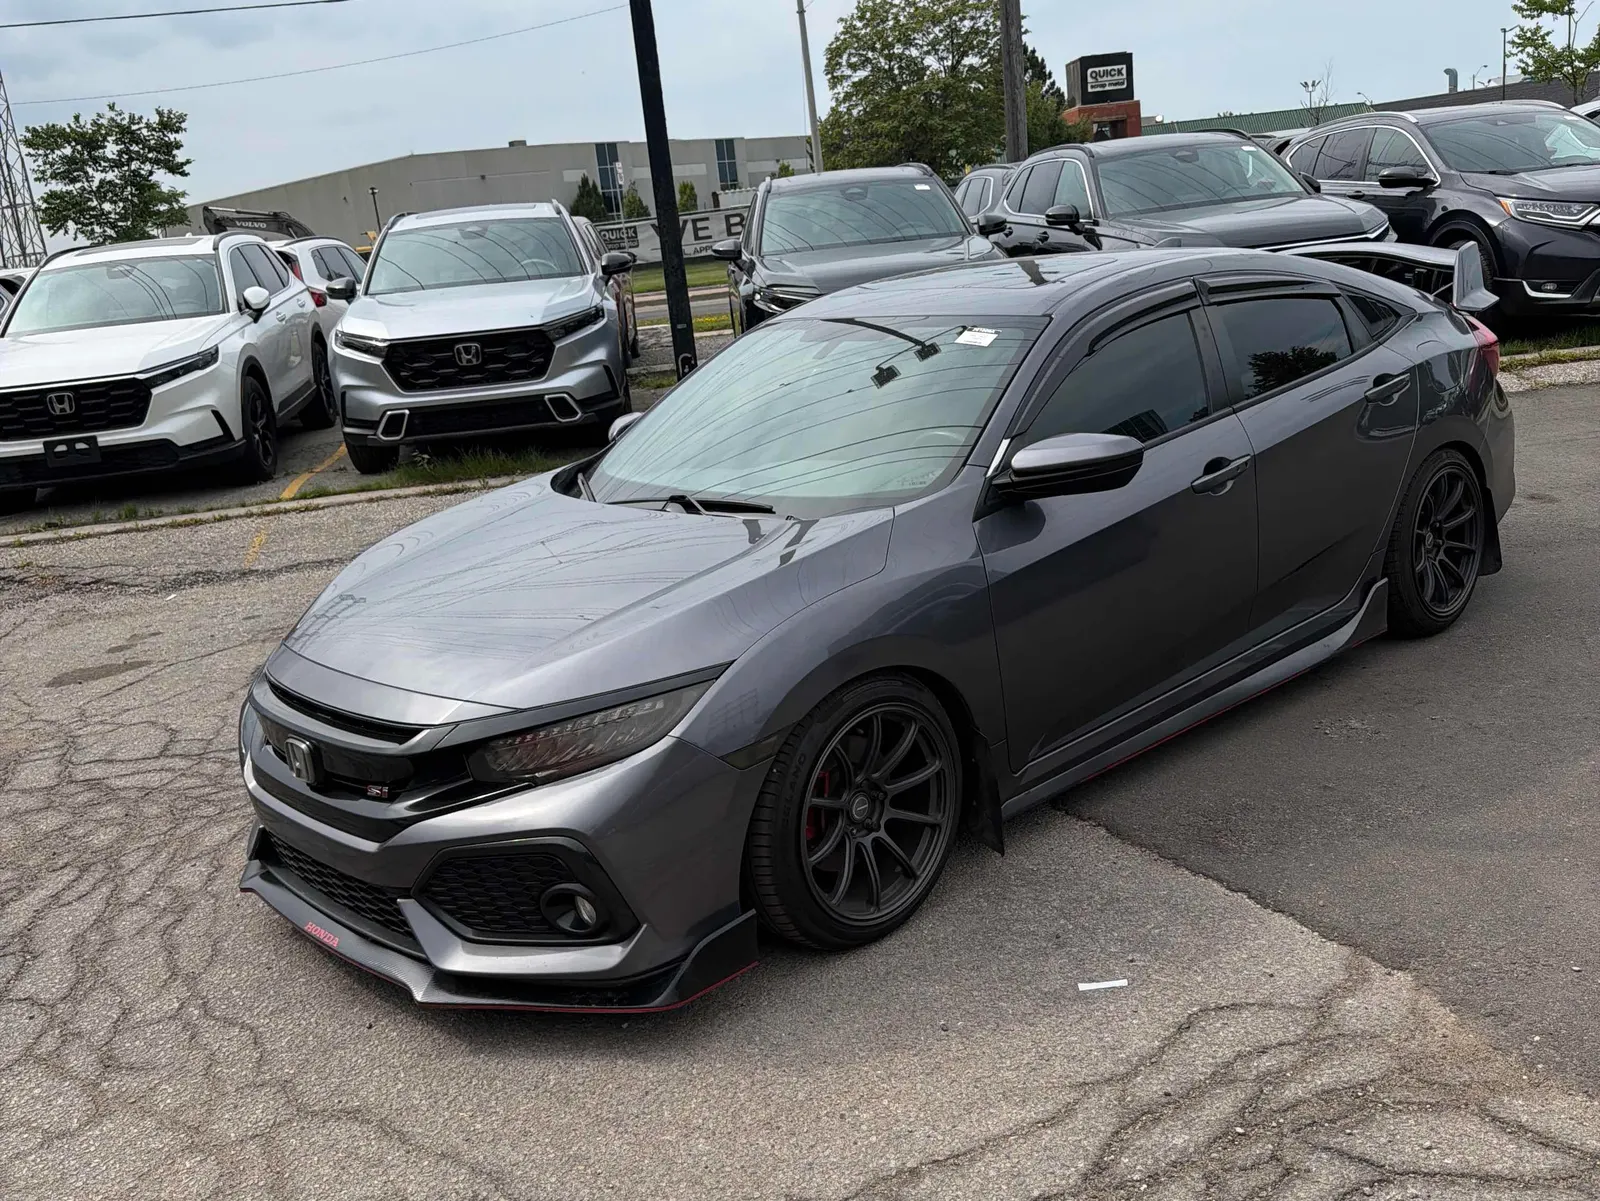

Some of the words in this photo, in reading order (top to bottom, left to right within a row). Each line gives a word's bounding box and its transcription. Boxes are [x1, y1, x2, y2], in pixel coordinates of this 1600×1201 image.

[1090, 67, 1124, 81] QUICK
[235, 220, 267, 228] VOLVO
[600, 228, 636, 241] QUICK
[304, 921, 340, 948] HONDA
